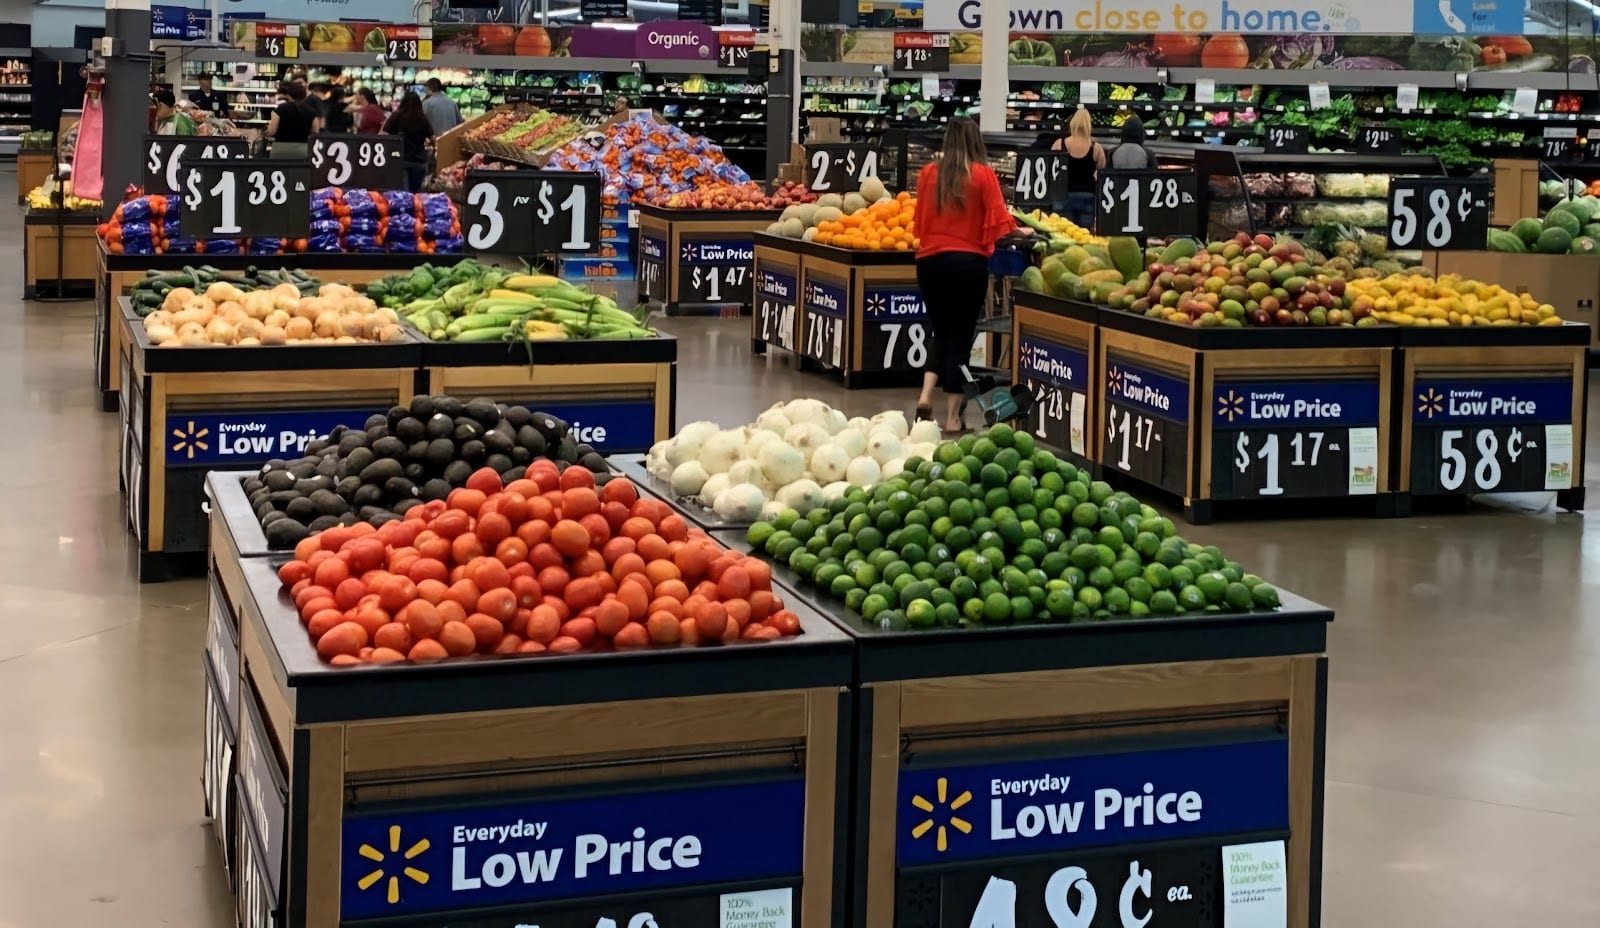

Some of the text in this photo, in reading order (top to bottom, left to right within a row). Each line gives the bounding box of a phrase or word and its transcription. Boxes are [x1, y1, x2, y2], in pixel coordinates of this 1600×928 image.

[958, 0, 1330, 31] Gwn close to home.
[648, 31, 699, 49] Organic
[811, 150, 831, 191] 2
[467, 180, 591, 250] 3 $1
[701, 248, 725, 260] Low
[891, 301, 920, 315] Low
[762, 300, 770, 341] 2
[880, 323, 934, 369] 78
[1033, 354, 1073, 380] Low Price
[1123, 378, 1170, 411] Low Price
[1251, 392, 1285, 402] Everyday
[1449, 396, 1537, 415] Low Price
[1450, 390, 1483, 400] Everyday
[1250, 398, 1342, 418] Low Price
[219, 422, 267, 433] Everyday
[567, 421, 607, 443] ice
[219, 429, 330, 455] Low Pri
[991, 773, 1071, 796] Everyday
[990, 782, 1204, 841] Low Price
[453, 819, 548, 843] Everyday
[452, 827, 702, 891] Low Price
[1166, 885, 1193, 902] ea.
[763, 905, 785, 917] Back
